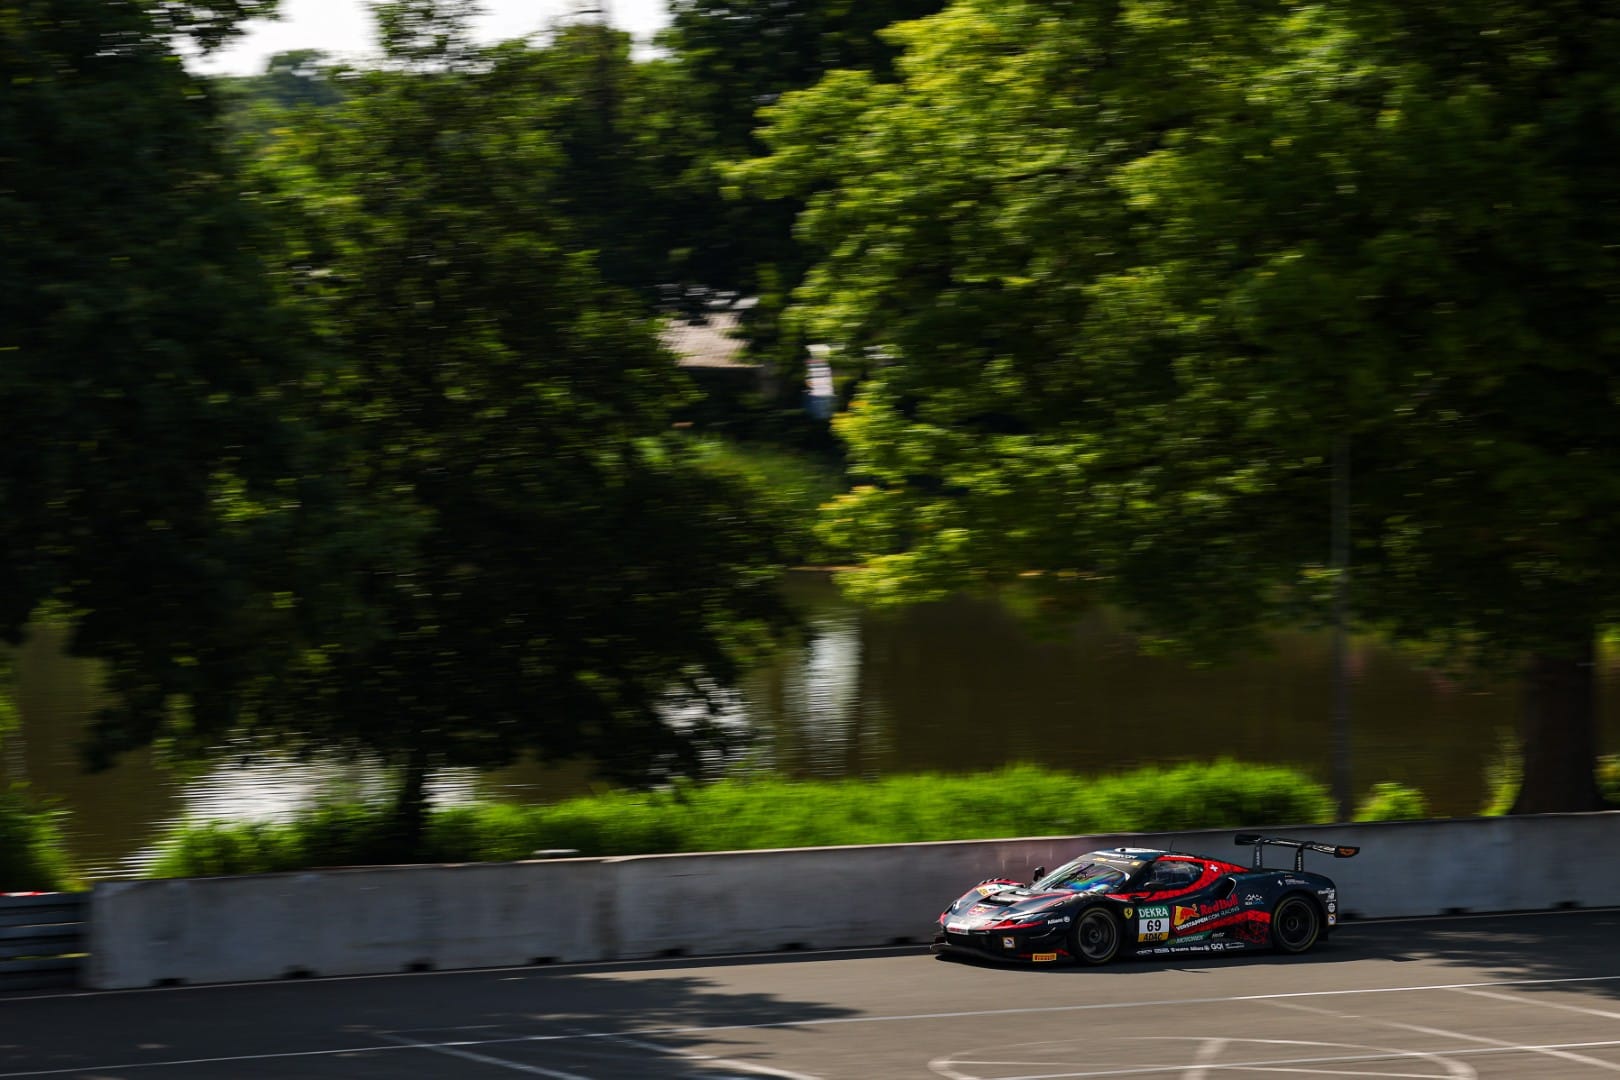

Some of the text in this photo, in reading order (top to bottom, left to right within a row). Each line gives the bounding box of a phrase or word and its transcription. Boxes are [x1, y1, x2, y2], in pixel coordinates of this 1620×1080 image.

[1200, 893, 1239, 915] Red Bull
[1139, 907, 1169, 918] DEKRA
[1146, 919, 1162, 932] 69
